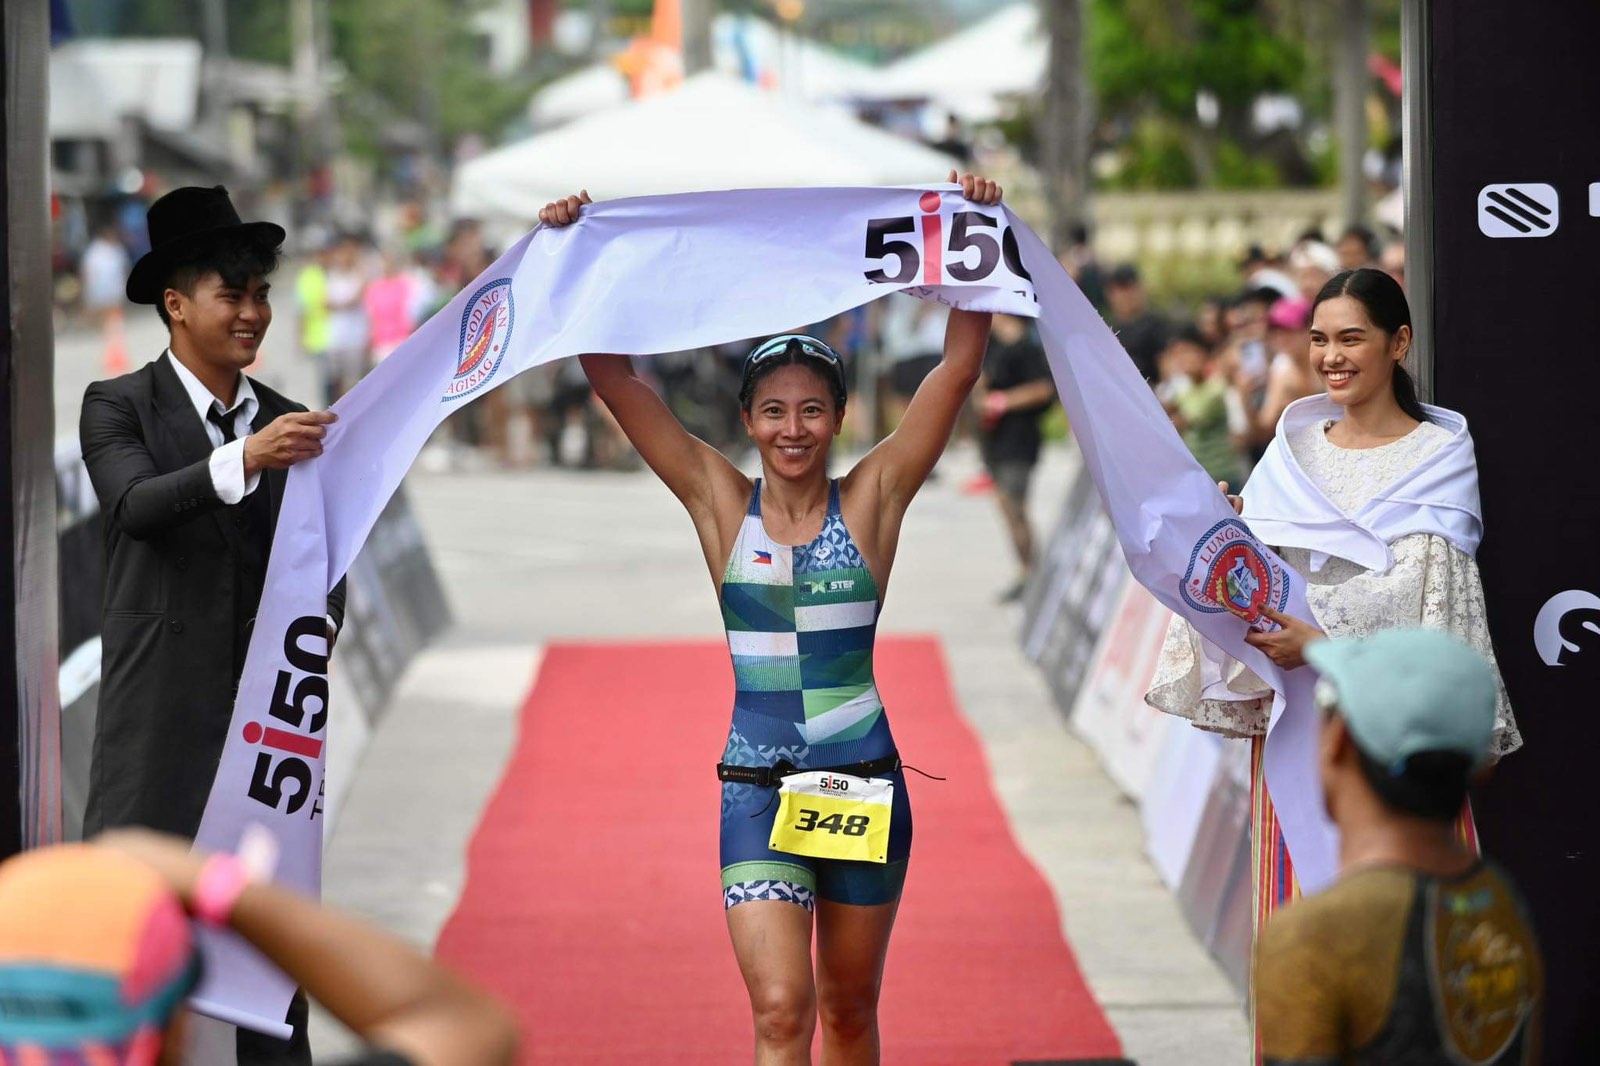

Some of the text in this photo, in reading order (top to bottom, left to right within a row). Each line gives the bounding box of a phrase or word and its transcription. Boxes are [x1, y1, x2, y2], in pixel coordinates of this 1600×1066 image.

[446, 358, 493, 394] AGISAG
[243, 616, 329, 815] 5i50
[820, 775, 848, 791] 5i50
[795, 809, 870, 837] 348
